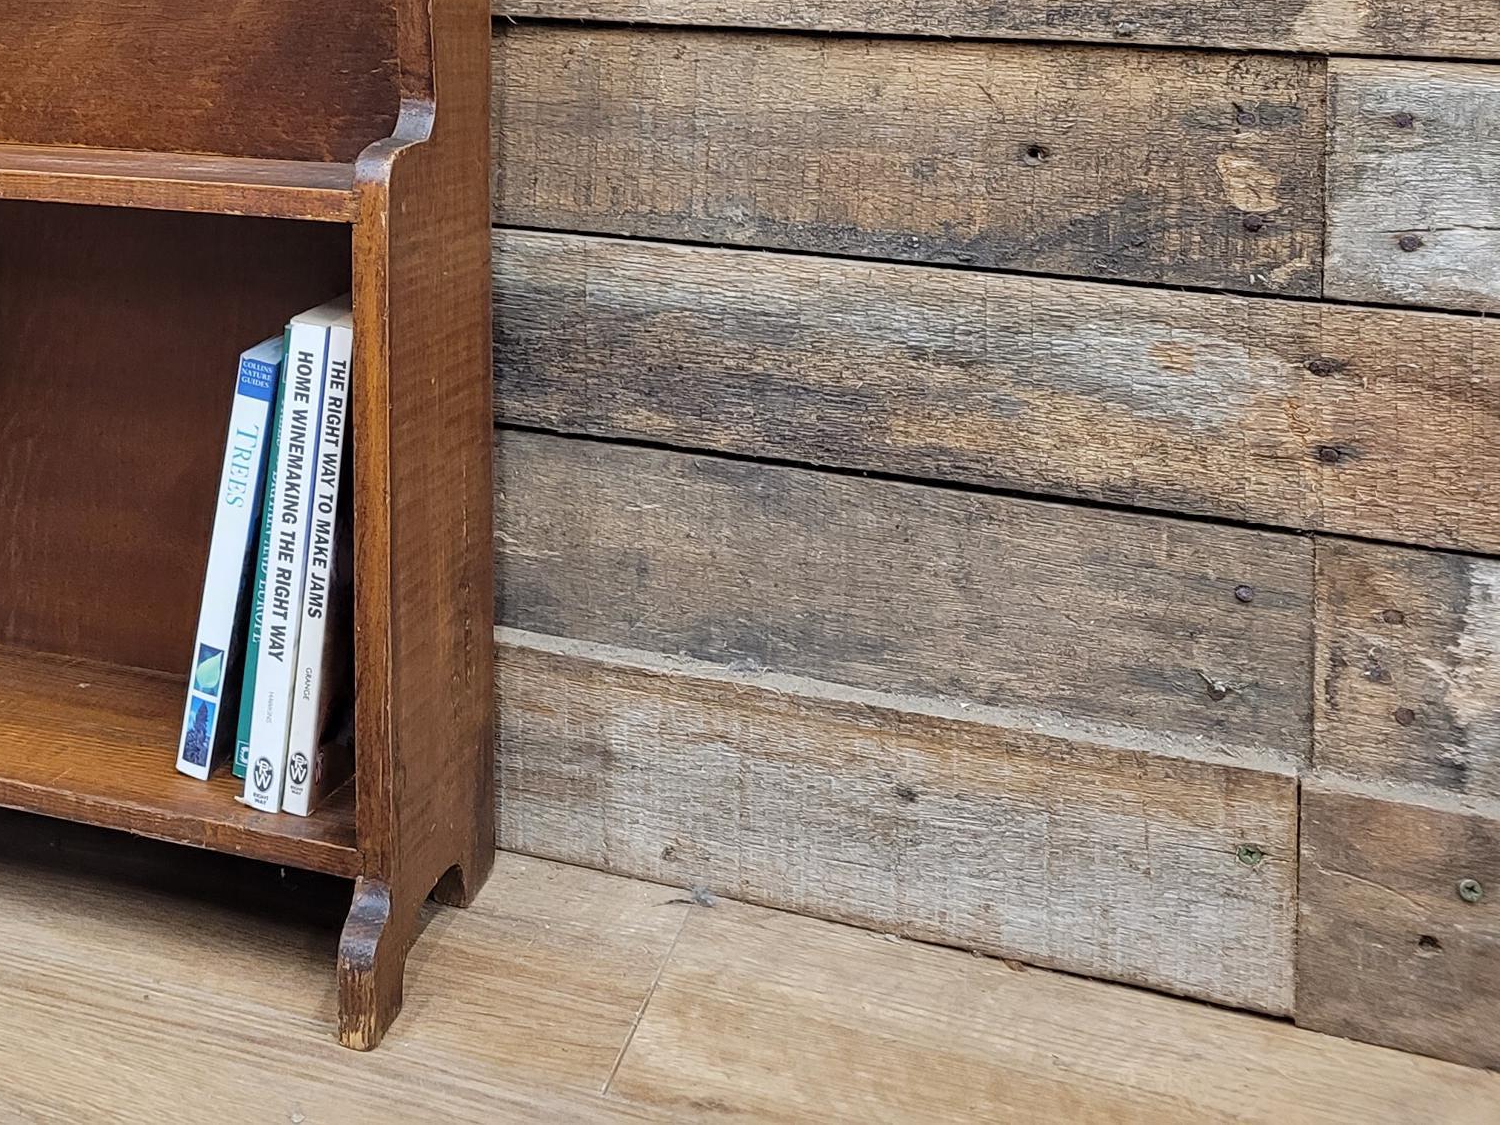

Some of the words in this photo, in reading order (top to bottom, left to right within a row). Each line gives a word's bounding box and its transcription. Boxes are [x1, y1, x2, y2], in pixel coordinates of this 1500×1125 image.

[241, 377, 269, 389] GUIDES
[242, 369, 272, 381] NATURE
[243, 361, 273, 374] COLLINS
[294, 351, 314, 404] HOME
[330, 360, 347, 392] THE
[324, 396, 343, 447] RIGHT
[225, 424, 259, 507] TREES
[282, 410, 308, 525] WINEMAKING
[320, 452, 338, 488] WAY
[318, 494, 333, 514] TO
[278, 532, 296, 564] THE
[312, 519, 331, 569] MAKE
[272, 566, 292, 621] RIGHT
[307, 572, 326, 619] JAMS
[268, 625, 286, 663] WAY
[303, 667, 312, 701] GRANGE
